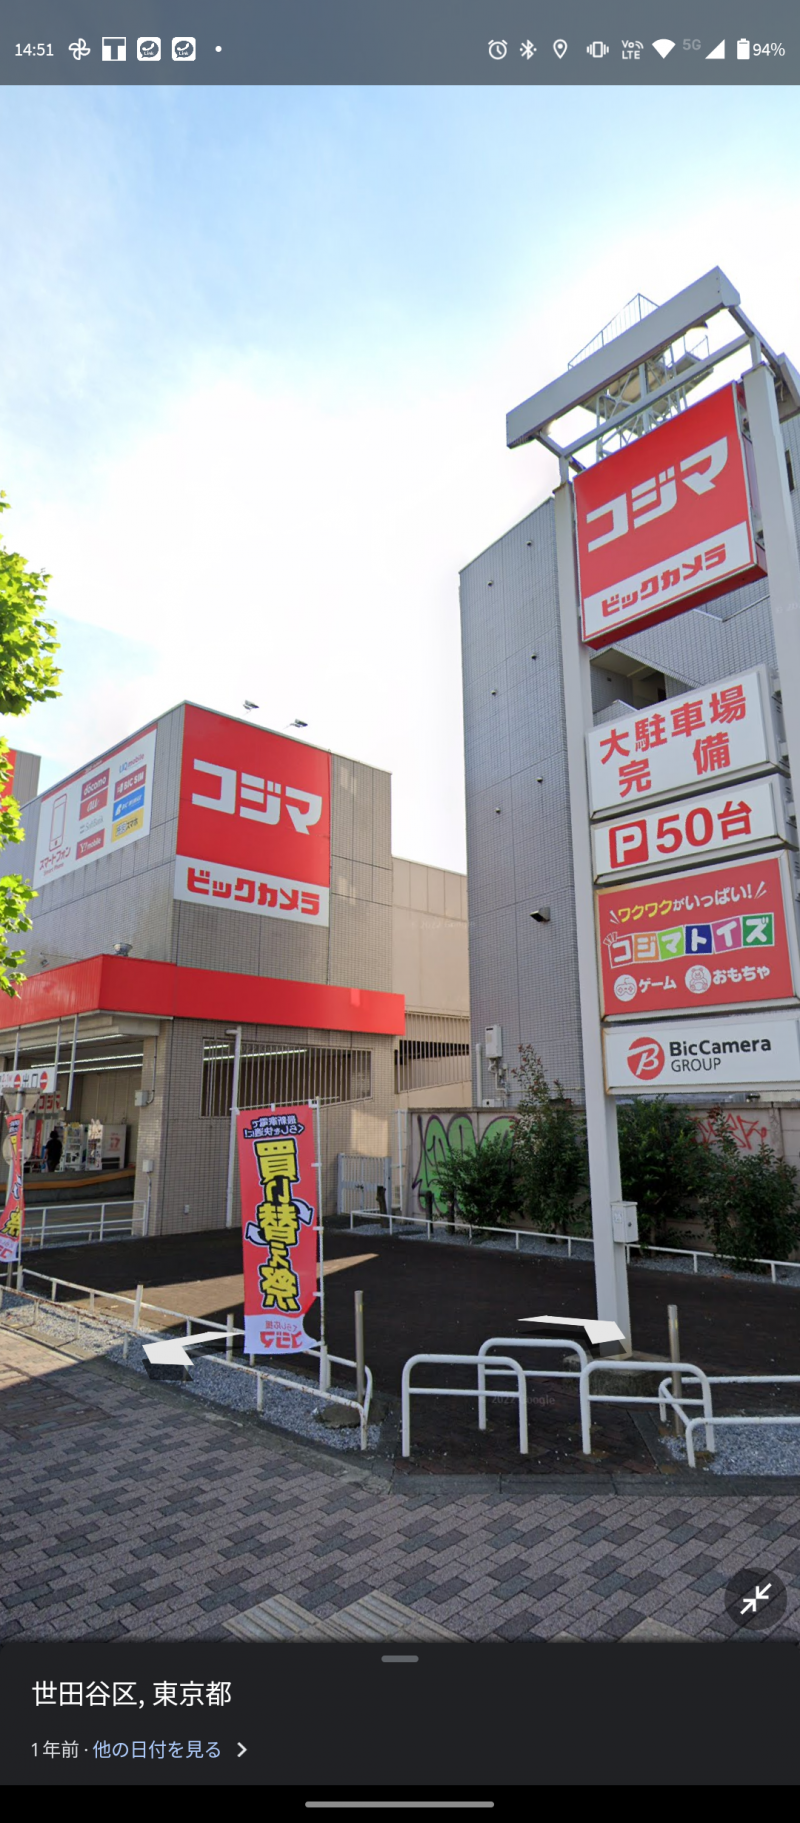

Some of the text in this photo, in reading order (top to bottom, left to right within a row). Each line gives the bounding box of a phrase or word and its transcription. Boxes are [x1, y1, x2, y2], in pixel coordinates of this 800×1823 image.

[586, 435, 729, 553] コジマ
[601, 542, 727, 618] ビックカメラ
[599, 684, 747, 765] 大駐車場
[83, 776, 107, 796] docomo
[191, 758, 323, 835] コジマ
[656, 800, 753, 854] 50台
[39, 846, 71, 871] スマートフォン
[186, 866, 320, 916] ビックカメラ
[617, 884, 753, 923] ワクワクがいっぱい!
[611, 914, 772, 965] コジマトイズ
[638, 975, 677, 993] ゲーム
[712, 965, 771, 985] おもちゃ
[669, 1038, 771, 1057] BicCamera
[671, 1057, 721, 1073] GROUP
